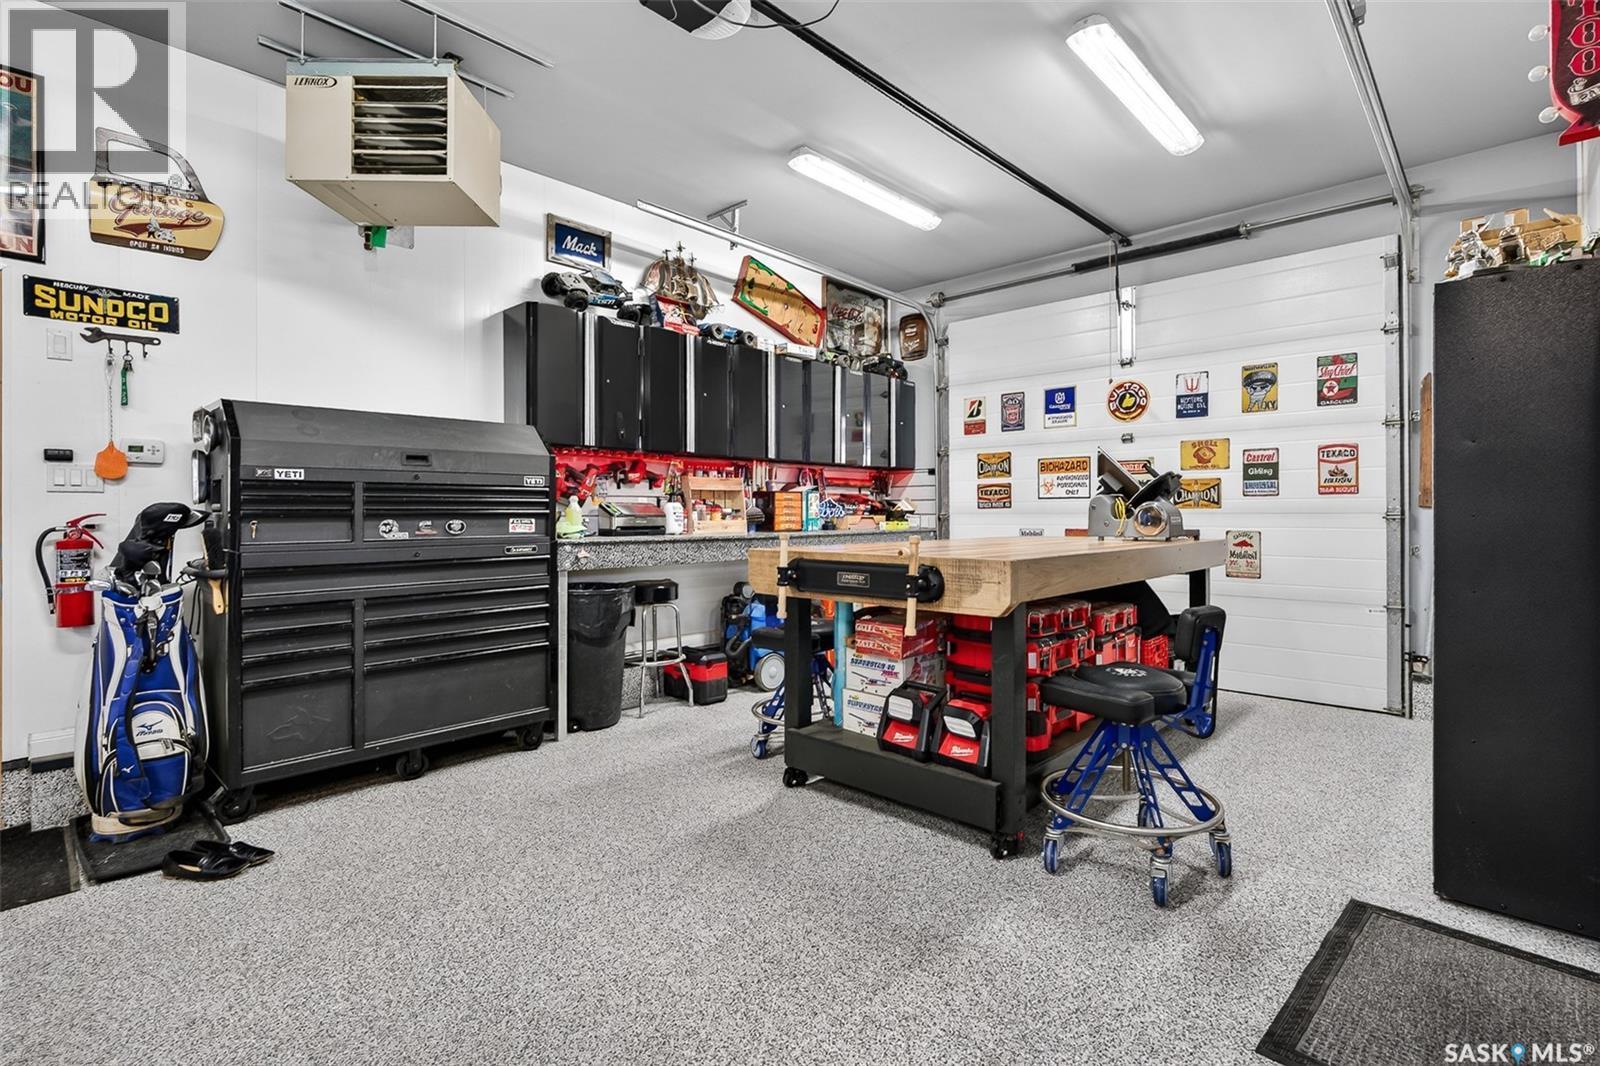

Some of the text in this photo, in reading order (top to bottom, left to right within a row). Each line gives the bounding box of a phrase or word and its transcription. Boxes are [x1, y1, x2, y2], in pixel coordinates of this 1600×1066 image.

[294, 77, 330, 86] LENNOX
[562, 235, 598, 257] Mack
[53, 282, 151, 301] MERCURY MADE
[34, 283, 170, 324] SUNOCO
[50, 310, 160, 332] MOTOR OIL
[1109, 383, 1147, 411] BULTACO
[1191, 440, 1218, 449] SHELL
[1246, 452, 1276, 463] Castrol
[1320, 449, 1356, 459] TEXACO
[1039, 459, 1089, 473] BIOHAZARD
[276, 470, 302, 478] YETI
[980, 488, 1009, 497] TEXACO
[1174, 486, 1218, 503] CHAMPION
